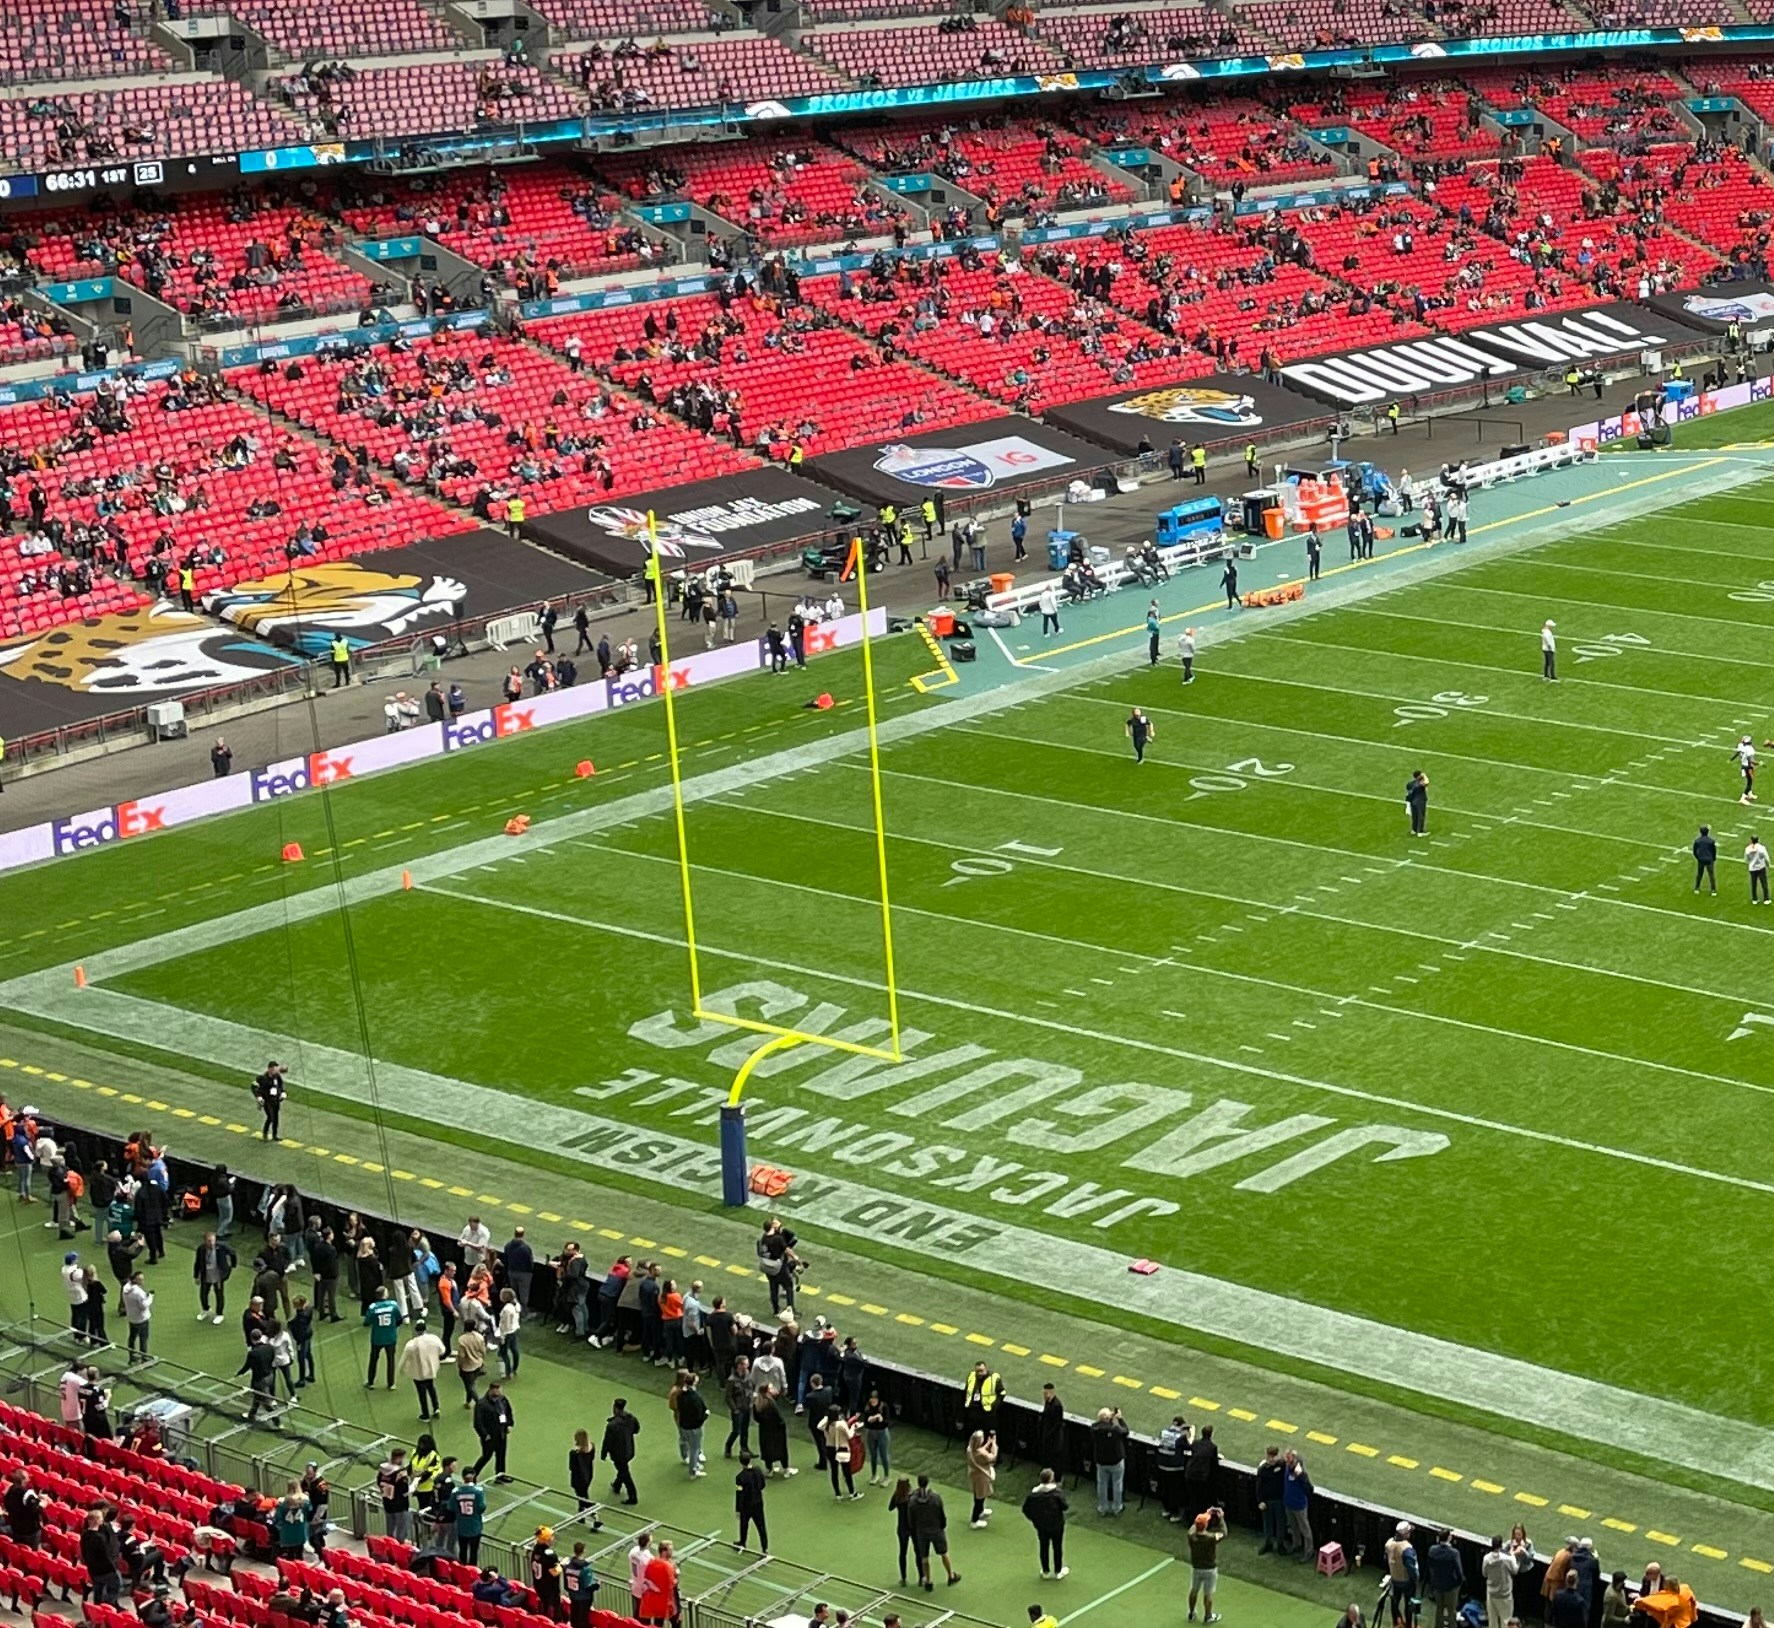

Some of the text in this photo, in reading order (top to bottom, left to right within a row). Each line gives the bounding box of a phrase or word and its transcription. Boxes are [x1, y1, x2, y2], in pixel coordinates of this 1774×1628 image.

[1470, 35, 1544, 51] BRONCOS
[1575, 30, 1651, 47] JAGUARS
[808, 89, 898, 113] BRONCOS
[933, 78, 1016, 101] JAGUARS
[45, 170, 96, 192] 66:31
[101, 169, 127, 183] 1ST
[994, 450, 1039, 467] IG
[687, 497, 822, 535] FOUNDATION
[1571, 632, 1652, 659] 40
[607, 664, 691, 708] FedEx
[1392, 690, 1490, 720] 30
[444, 703, 535, 752] FedEx
[251, 751, 354, 801] FedEx
[1189, 757, 1296, 794] 20
[53, 800, 166, 856] FedEx
[949, 839, 1064, 876] 10
[626, 980, 1452, 1193] JAGUARS
[572, 1067, 1181, 1229] JACKSONVILLE
[557, 1127, 1003, 1254] END RCISM
[284, 1508, 305, 1524] 44
